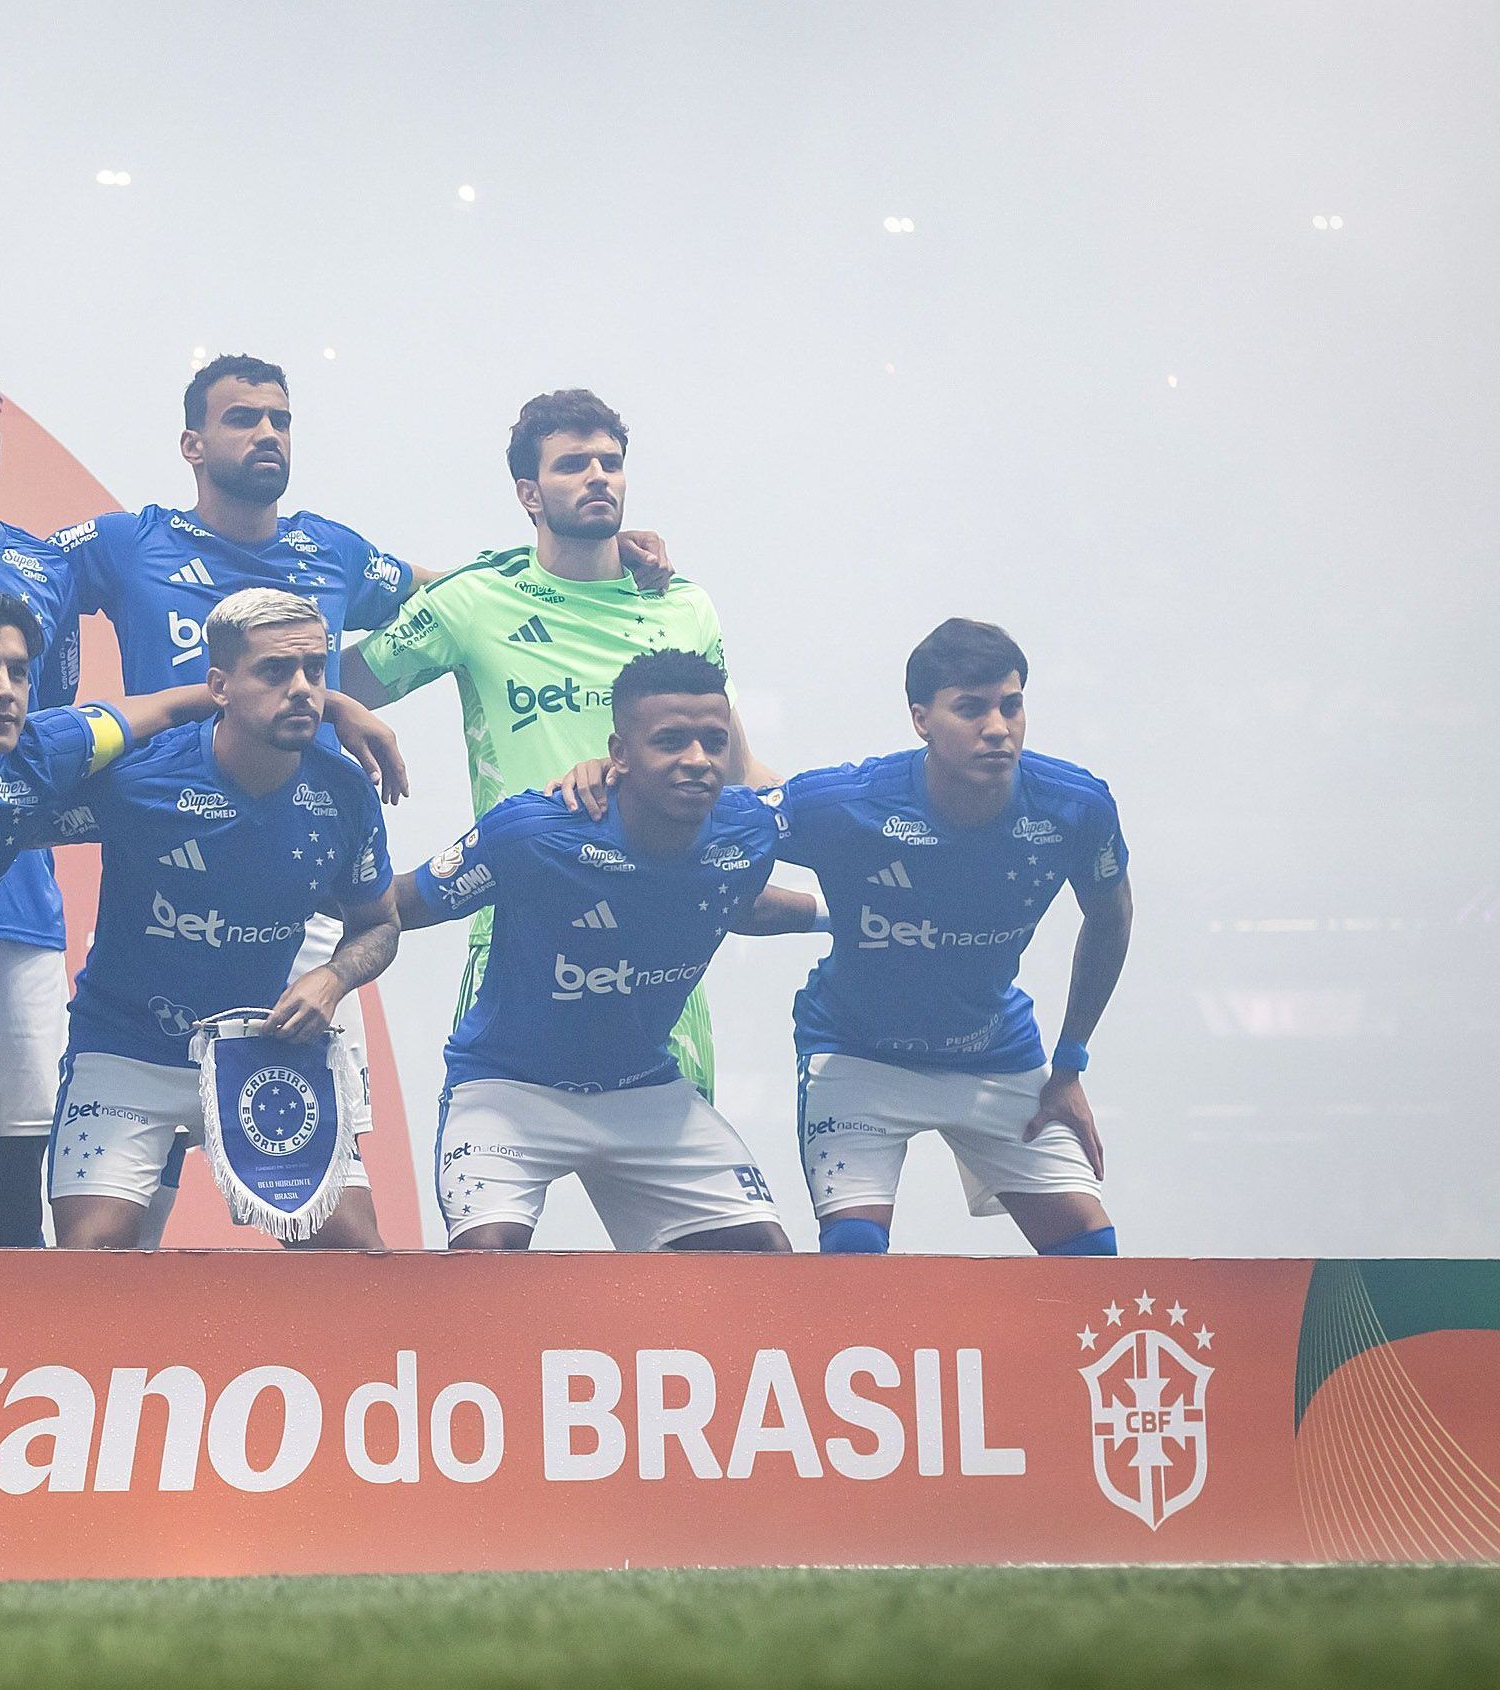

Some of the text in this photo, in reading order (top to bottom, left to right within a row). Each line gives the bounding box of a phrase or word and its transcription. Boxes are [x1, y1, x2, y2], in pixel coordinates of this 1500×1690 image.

[2, 548, 44, 571] Super
[22, 569, 48, 583] CIMED
[506, 677, 581, 733] bet
[177, 788, 229, 813] Super
[293, 784, 334, 811] Super
[204, 808, 237, 820] CIMED
[312, 807, 338, 817] CIMED
[882, 815, 932, 839] Super
[1012, 816, 1057, 841] Super
[1032, 833, 1063, 845] CIMED
[907, 836, 938, 846] CIMED
[578, 843, 627, 867] Super
[603, 863, 636, 872] CIMED
[721, 860, 751, 871] CIMED
[146, 890, 226, 948] bet
[858, 905, 939, 950] bet
[552, 953, 635, 1001] bet
[245, 1070, 308, 1098] CRUZEIRO
[64, 1101, 150, 1126] bet nacional
[242, 1101, 316, 1152] ESPORTE CLUBE
[807, 1116, 888, 1145] bet nacional
[343, 1350, 505, 1484] do
[541, 1346, 1027, 1481] BRASIL
[1125, 1411, 1172, 1434] CBF
